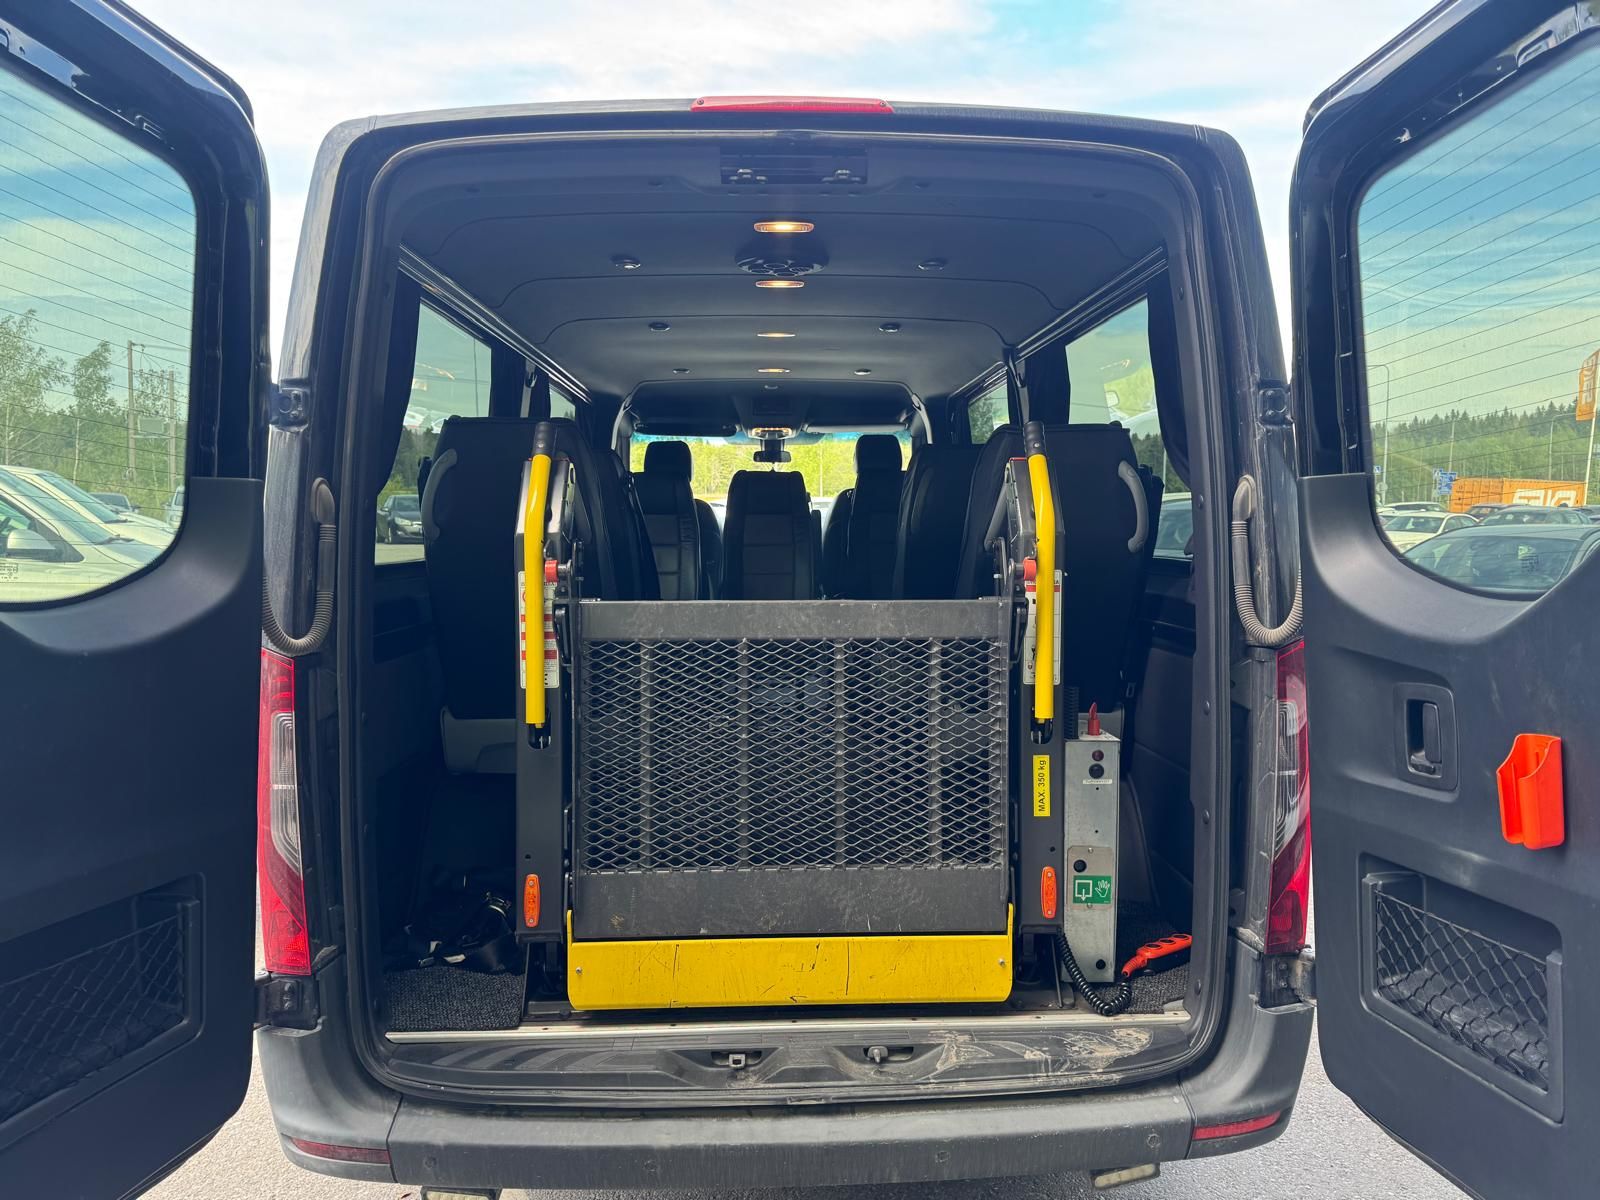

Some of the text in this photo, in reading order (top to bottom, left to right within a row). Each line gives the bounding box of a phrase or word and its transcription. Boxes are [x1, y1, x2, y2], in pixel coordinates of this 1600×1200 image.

[1038, 760, 1047, 812] MAX. 350 kg
